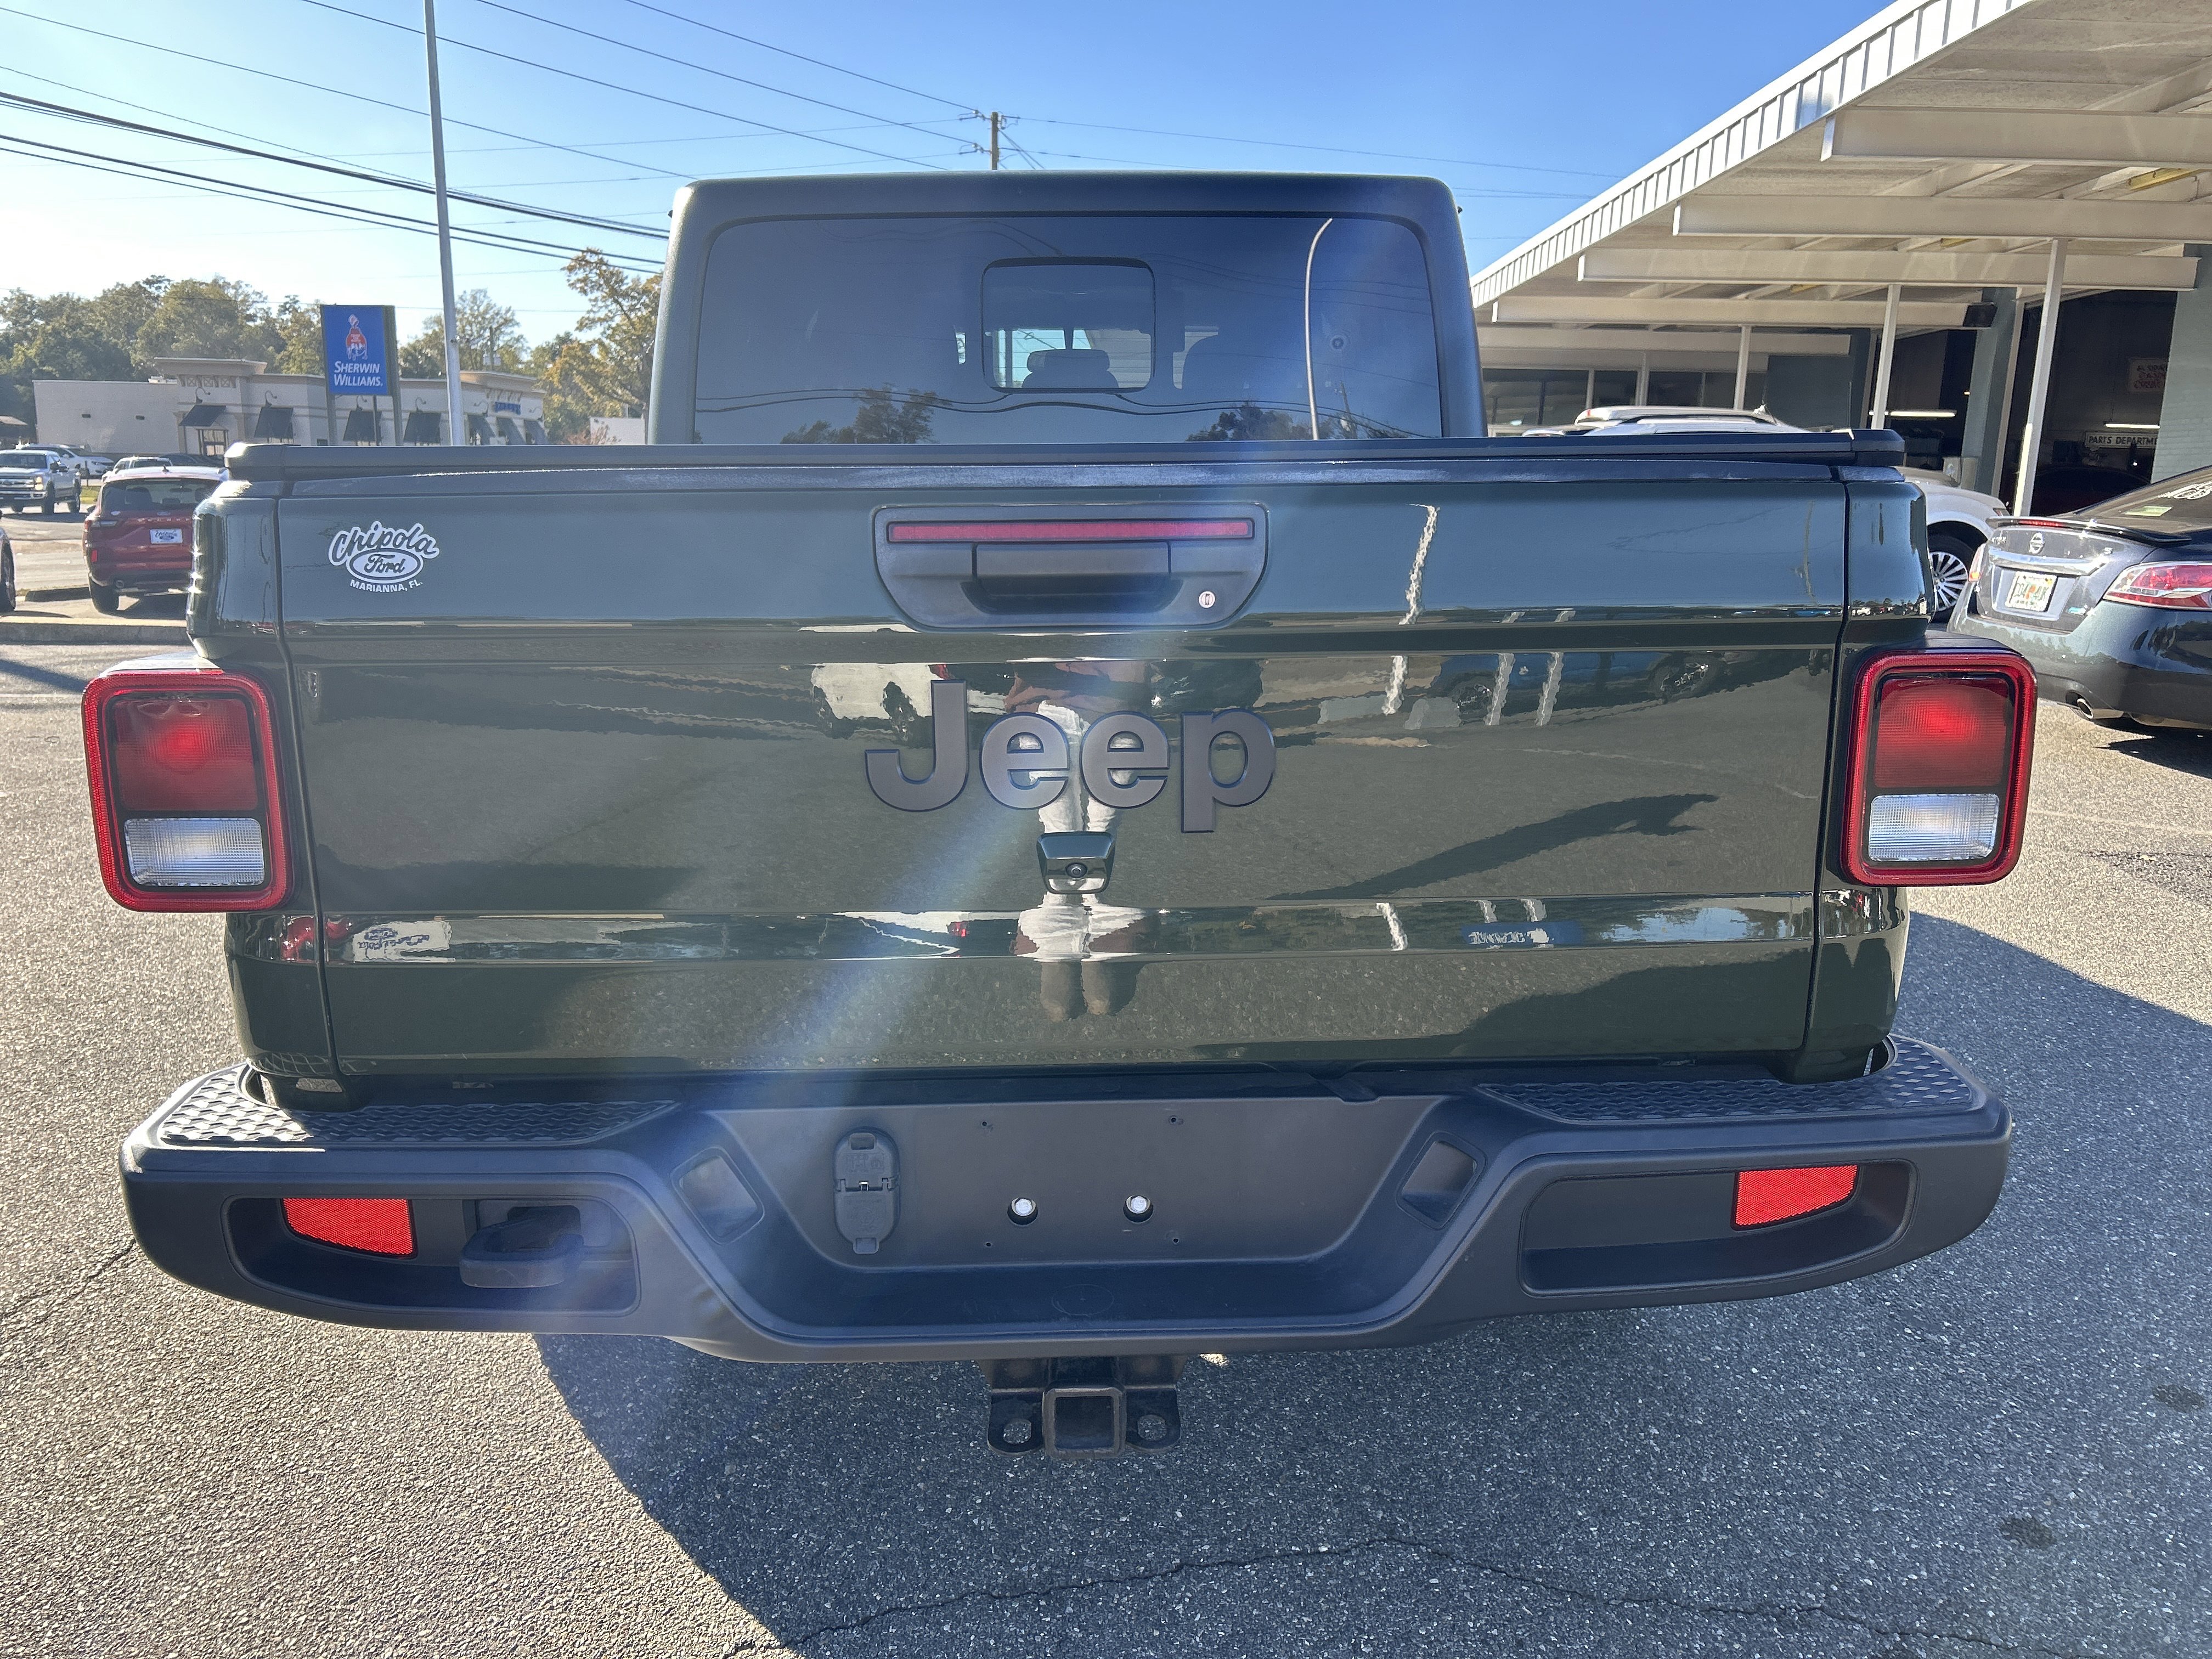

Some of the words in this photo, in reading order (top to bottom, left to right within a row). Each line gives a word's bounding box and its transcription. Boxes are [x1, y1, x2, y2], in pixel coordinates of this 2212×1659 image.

[334, 360, 381, 374] SHERWIN
[2088, 436, 2112, 444] PARTS
[331, 523, 438, 563] Chipola
[364, 554, 406, 573] Ford
[349, 579, 408, 593] MARIANNA,
[865, 679, 1277, 833] Jeep
